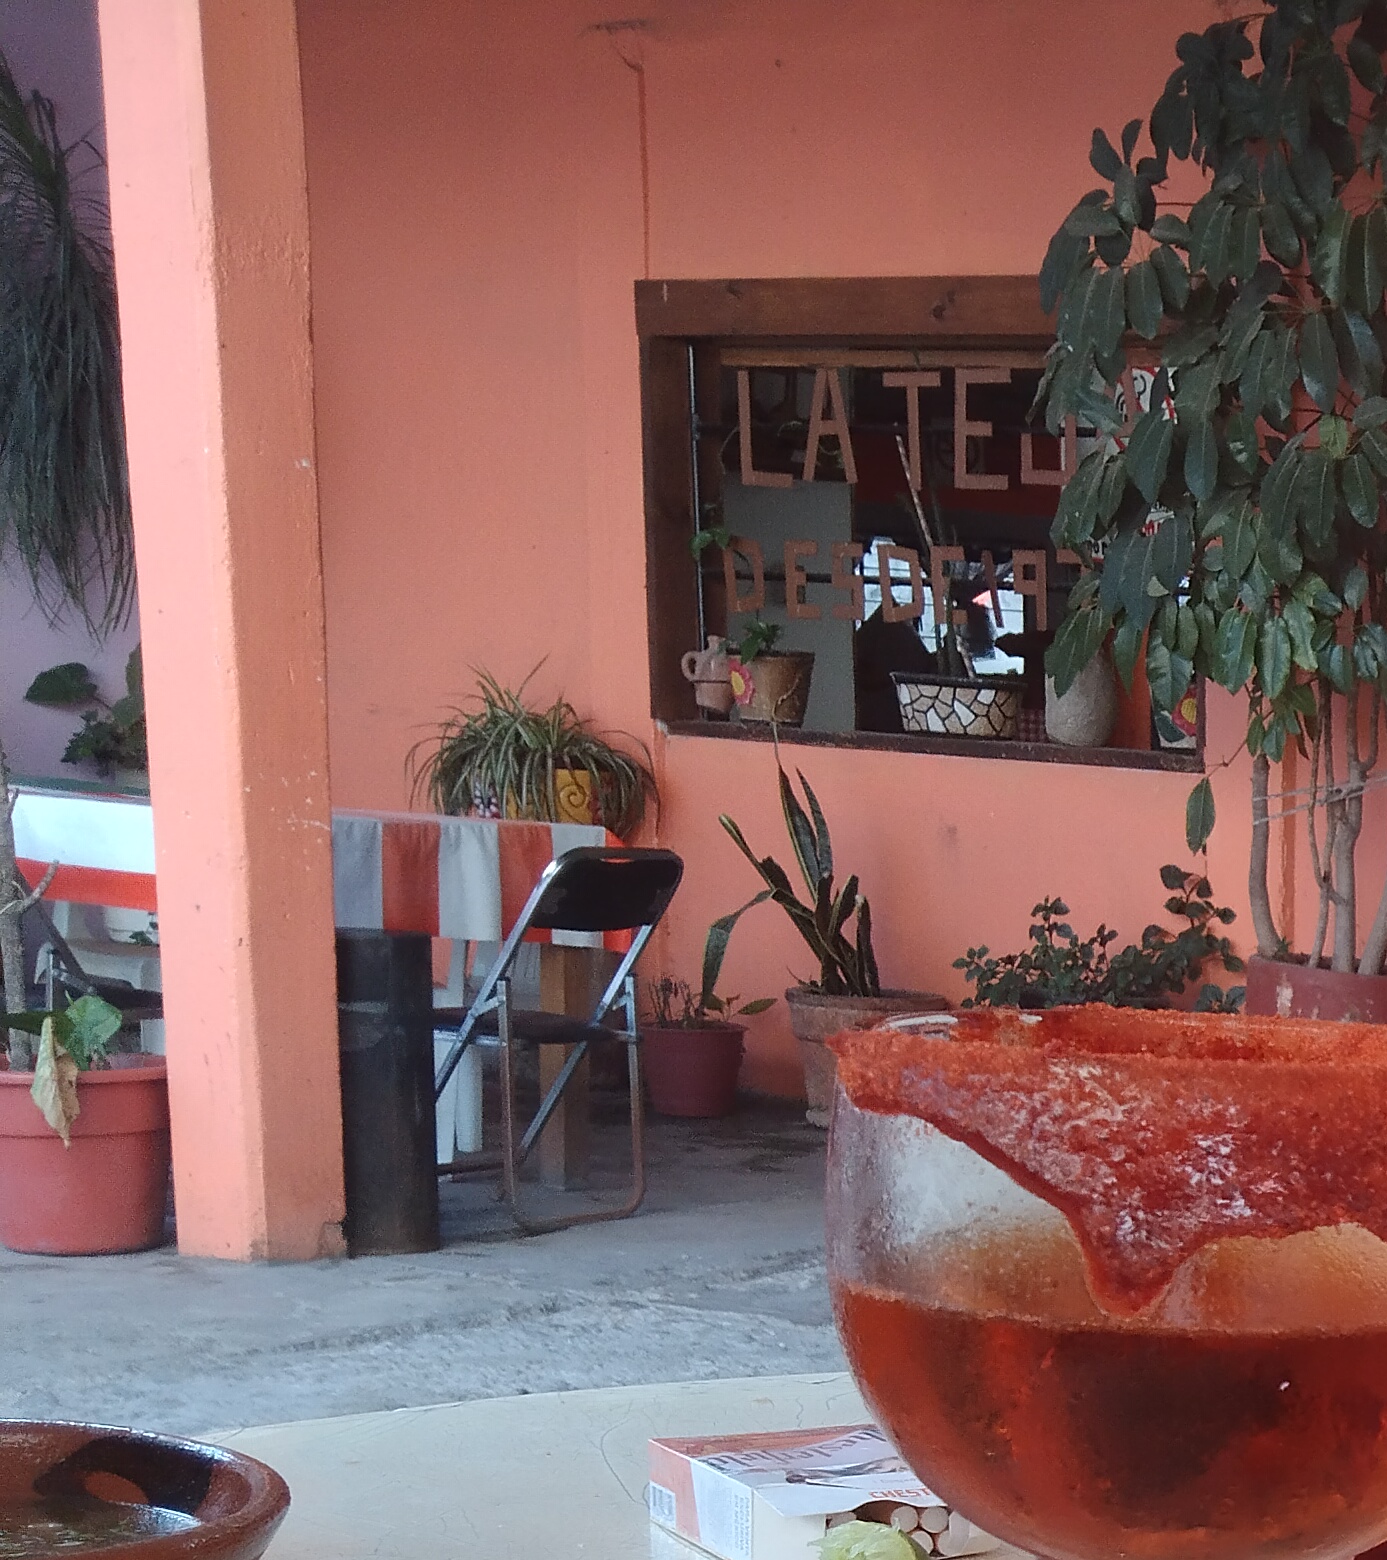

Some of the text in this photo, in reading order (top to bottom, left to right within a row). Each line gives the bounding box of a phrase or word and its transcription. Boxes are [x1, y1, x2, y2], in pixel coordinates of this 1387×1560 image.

[737, 366, 859, 489] LA
[722, 537, 970, 628] DESDE
[705, 1428, 889, 1474] hesterfield
